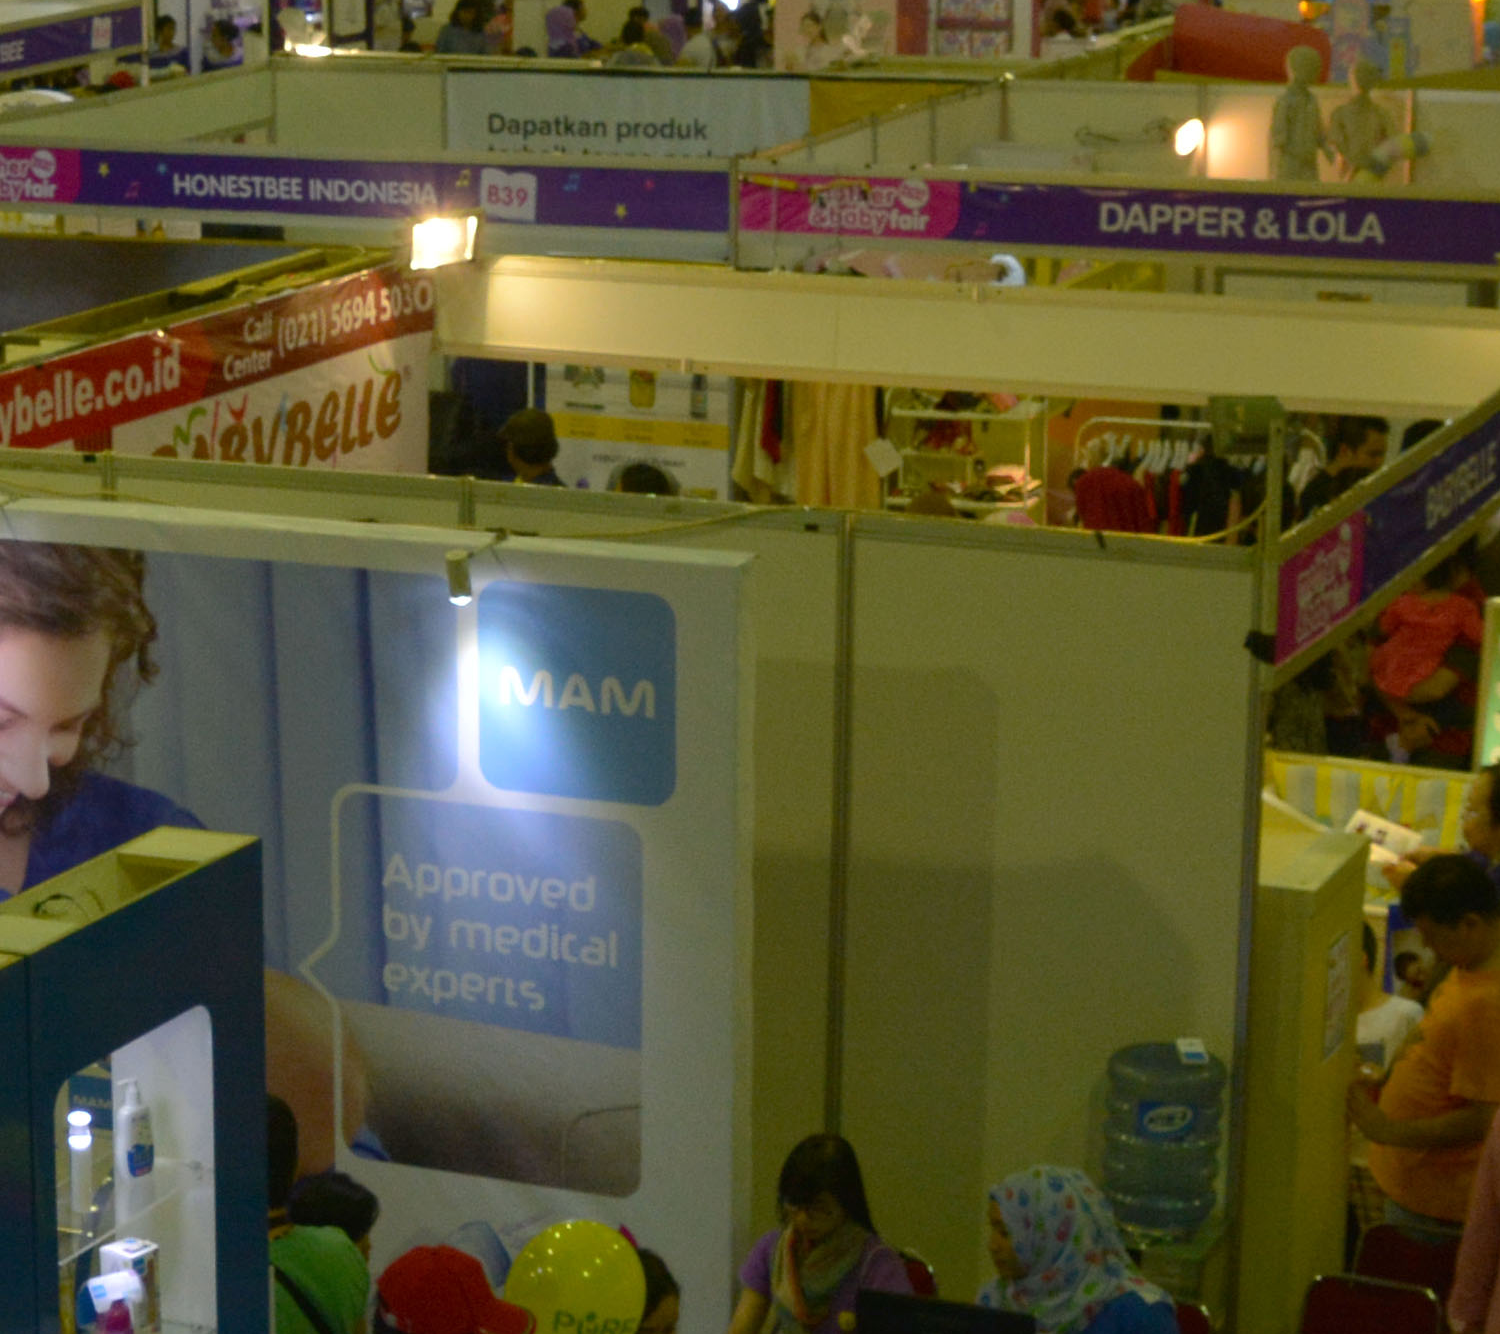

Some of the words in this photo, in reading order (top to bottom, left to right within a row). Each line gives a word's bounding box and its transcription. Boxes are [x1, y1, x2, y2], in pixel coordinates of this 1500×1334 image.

[487, 113, 607, 145] Dapatkan
[617, 115, 707, 147] produk
[25, 176, 58, 199] fair
[174, 171, 302, 203] HONESTBEE
[308, 174, 438, 207] INDONESIA
[887, 205, 930, 234] fair
[1099, 201, 1245, 238] DAPPER
[1252, 207, 1281, 240] &
[1289, 205, 1385, 245] LOLA
[243, 315, 273, 346] Call
[277, 310, 328, 353] (021)
[330, 289, 377, 339] 5694
[379, 278, 433, 323] 5030
[223, 350, 274, 381] Center
[500, 666, 655, 720] MAM
[382, 853, 597, 913] Approved
[382, 903, 431, 953] by
[450, 914, 618, 968] medical
[382, 960, 546, 1012] experts
